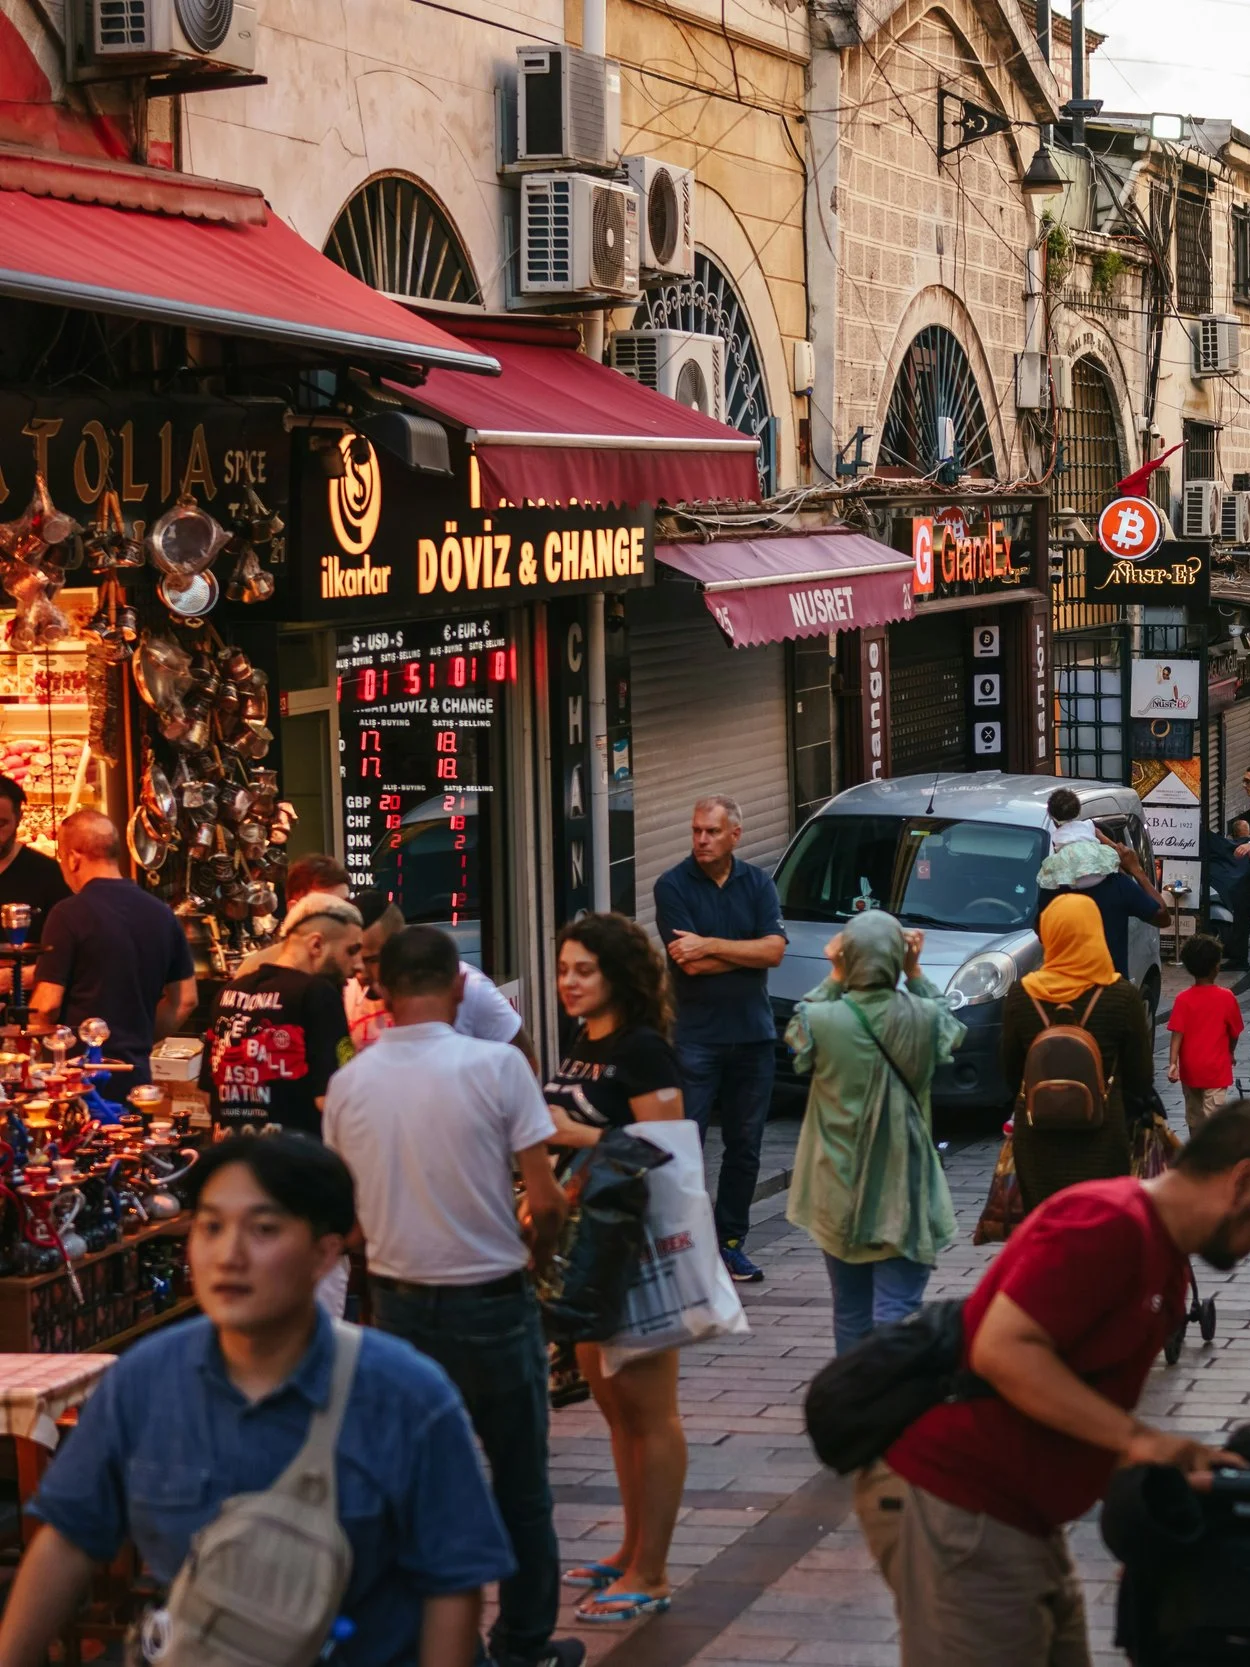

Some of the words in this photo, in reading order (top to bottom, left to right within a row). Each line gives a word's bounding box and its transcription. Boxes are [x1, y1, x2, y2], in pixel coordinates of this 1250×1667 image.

[418, 519, 511, 595] DÖVİZ
[519, 542, 537, 585] &
[544, 527, 645, 583] CHANGE
[916, 525, 931, 585] G
[941, 521, 1012, 583] GrandEx
[321, 554, 391, 599] ilkarlar
[789, 586, 853, 628] NUSRET
[442, 699, 494, 713] CHANGE
[346, 796, 371, 810] GBP
[346, 815, 371, 828] CHF
[347, 835, 372, 847] DKK
[1165, 836, 1196, 850] Delight
[347, 854, 371, 867] SEK
[220, 990, 283, 1010] NATIONAL
[246, 1039, 293, 1077] BALL
